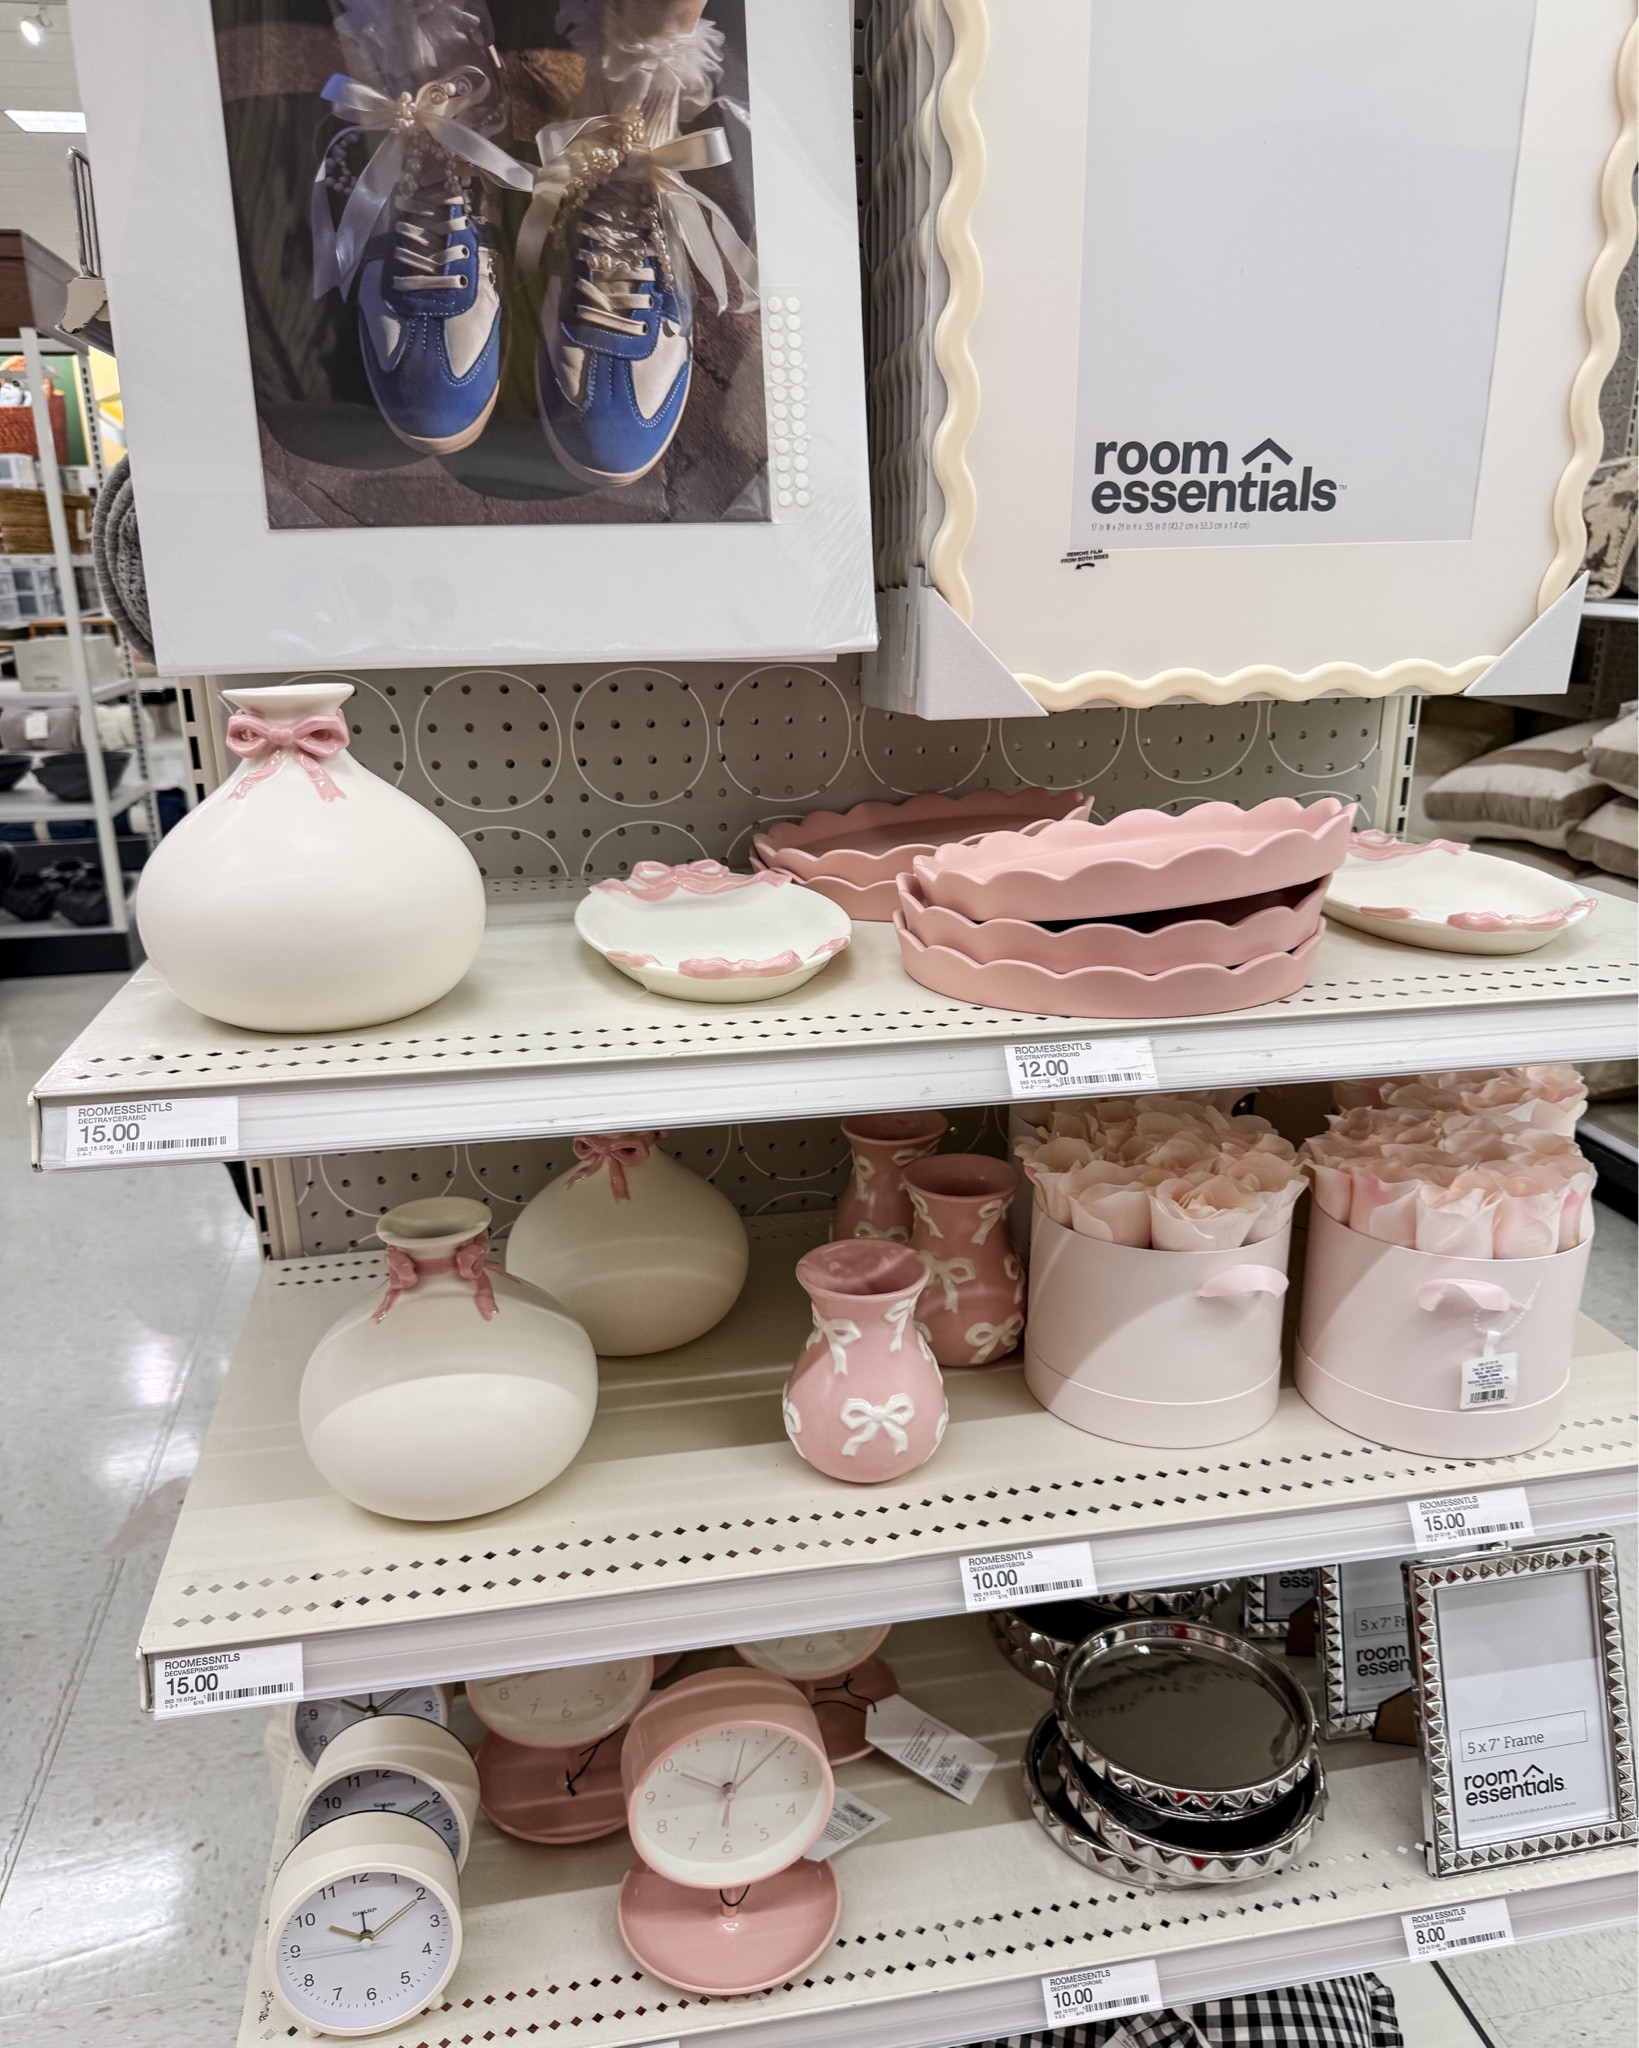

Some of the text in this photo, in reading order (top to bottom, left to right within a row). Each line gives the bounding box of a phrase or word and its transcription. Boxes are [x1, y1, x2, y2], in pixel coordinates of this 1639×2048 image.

[1094, 440, 1228, 475] room
[1091, 462, 1337, 514] essentials
[1014, 1042, 1092, 1054] ROOMESSENTLS
[1019, 1059, 1069, 1078] 12.00
[78, 1102, 173, 1118] ROOMESSENTLS
[78, 1114, 147, 1125] DECTRAYCERAMIC
[80, 1123, 140, 1144] 15.00
[1419, 1495, 1479, 1510] ROOMESSNTLS
[1424, 1512, 1465, 1532] 15.00
[968, 1550, 1034, 1566] ROOMESSNTLS
[972, 1569, 1018, 1590] 10.00
[1361, 1620, 1368, 1631] 5
[1370, 1620, 1378, 1630] x
[1356, 1644, 1406, 1662] room
[165, 1653, 240, 1670] ROOMESSNTLS
[1357, 1659, 1411, 1677] essen
[165, 1664, 229, 1677] DECVASEPINKBOWS
[166, 1673, 219, 1696] 15.00
[424, 1700, 434, 1712] 3
[309, 1709, 318, 1721] 9
[789, 1741, 798, 1755] 2
[1468, 1741, 1476, 1755] 5
[1478, 1742, 1487, 1753] x
[1504, 1732, 1545, 1749] Frame
[345, 1775, 360, 1787] 11
[800, 1771, 809, 1785] 3
[1464, 1768, 1518, 1790] room
[1465, 1773, 1565, 1806] essentials
[323, 1796, 342, 1809] 10
[431, 1791, 441, 1804] 2
[645, 1791, 656, 1805] 9
[786, 1802, 796, 1815] 4
[443, 1818, 453, 1831] 3
[656, 1819, 667, 1834] 8
[759, 1828, 770, 1841] 5
[687, 1837, 698, 1851] 7
[721, 1841, 733, 1854] 6
[318, 1885, 336, 1900] 11
[415, 1886, 426, 1901] 2
[295, 1912, 316, 1928] 10
[429, 1914, 440, 1928] 3
[1411, 1907, 1466, 1924] ROOM ESSNTLS
[1416, 1926, 1446, 1945] 8.00
[290, 1944, 301, 1959] 9
[422, 1942, 433, 1955] 4
[304, 1973, 315, 1987] 8
[400, 1971, 411, 1985] 5
[1050, 1969, 1111, 1986] ROOMESSENTLS
[332, 1987, 343, 2001] 7
[366, 1987, 377, 2001] 6
[1053, 1987, 1093, 2008] 10.00
